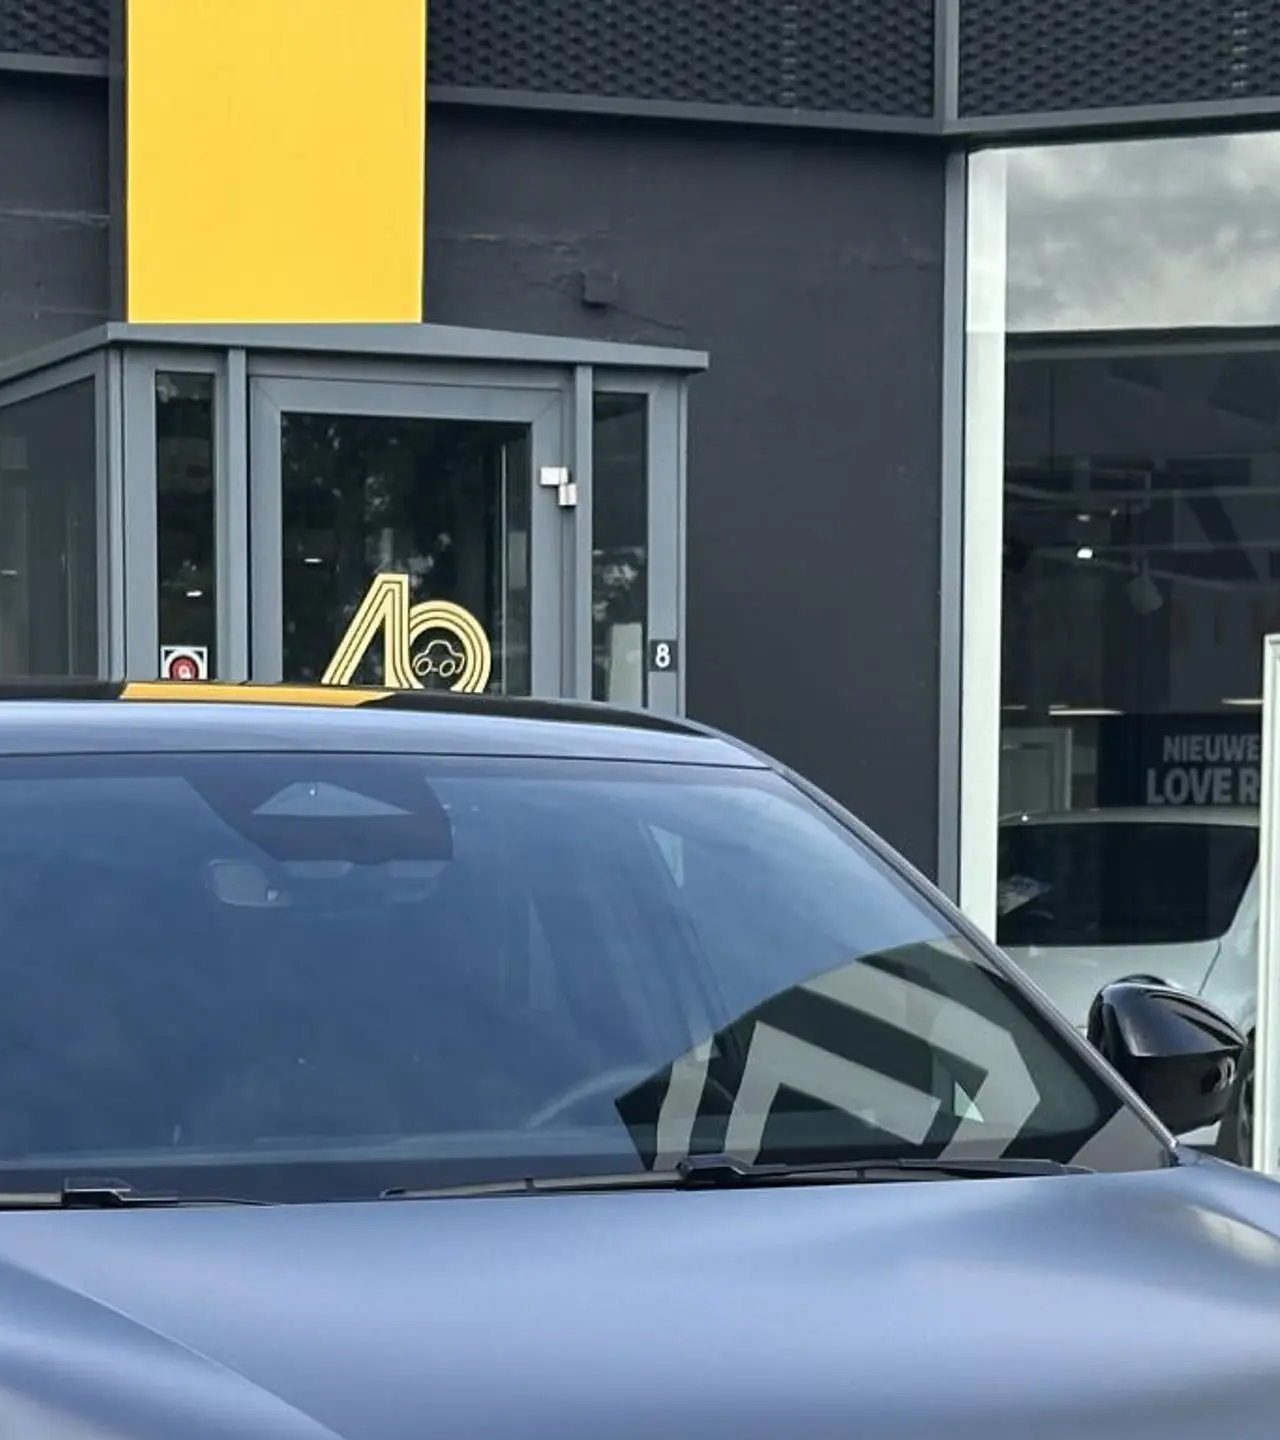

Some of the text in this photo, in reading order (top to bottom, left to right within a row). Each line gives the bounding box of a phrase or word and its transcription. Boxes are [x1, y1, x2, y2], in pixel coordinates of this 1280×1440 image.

[655, 644, 671, 668] 8
[1162, 733, 1261, 763] NIEUWE
[1146, 766, 1233, 805] LOVE
